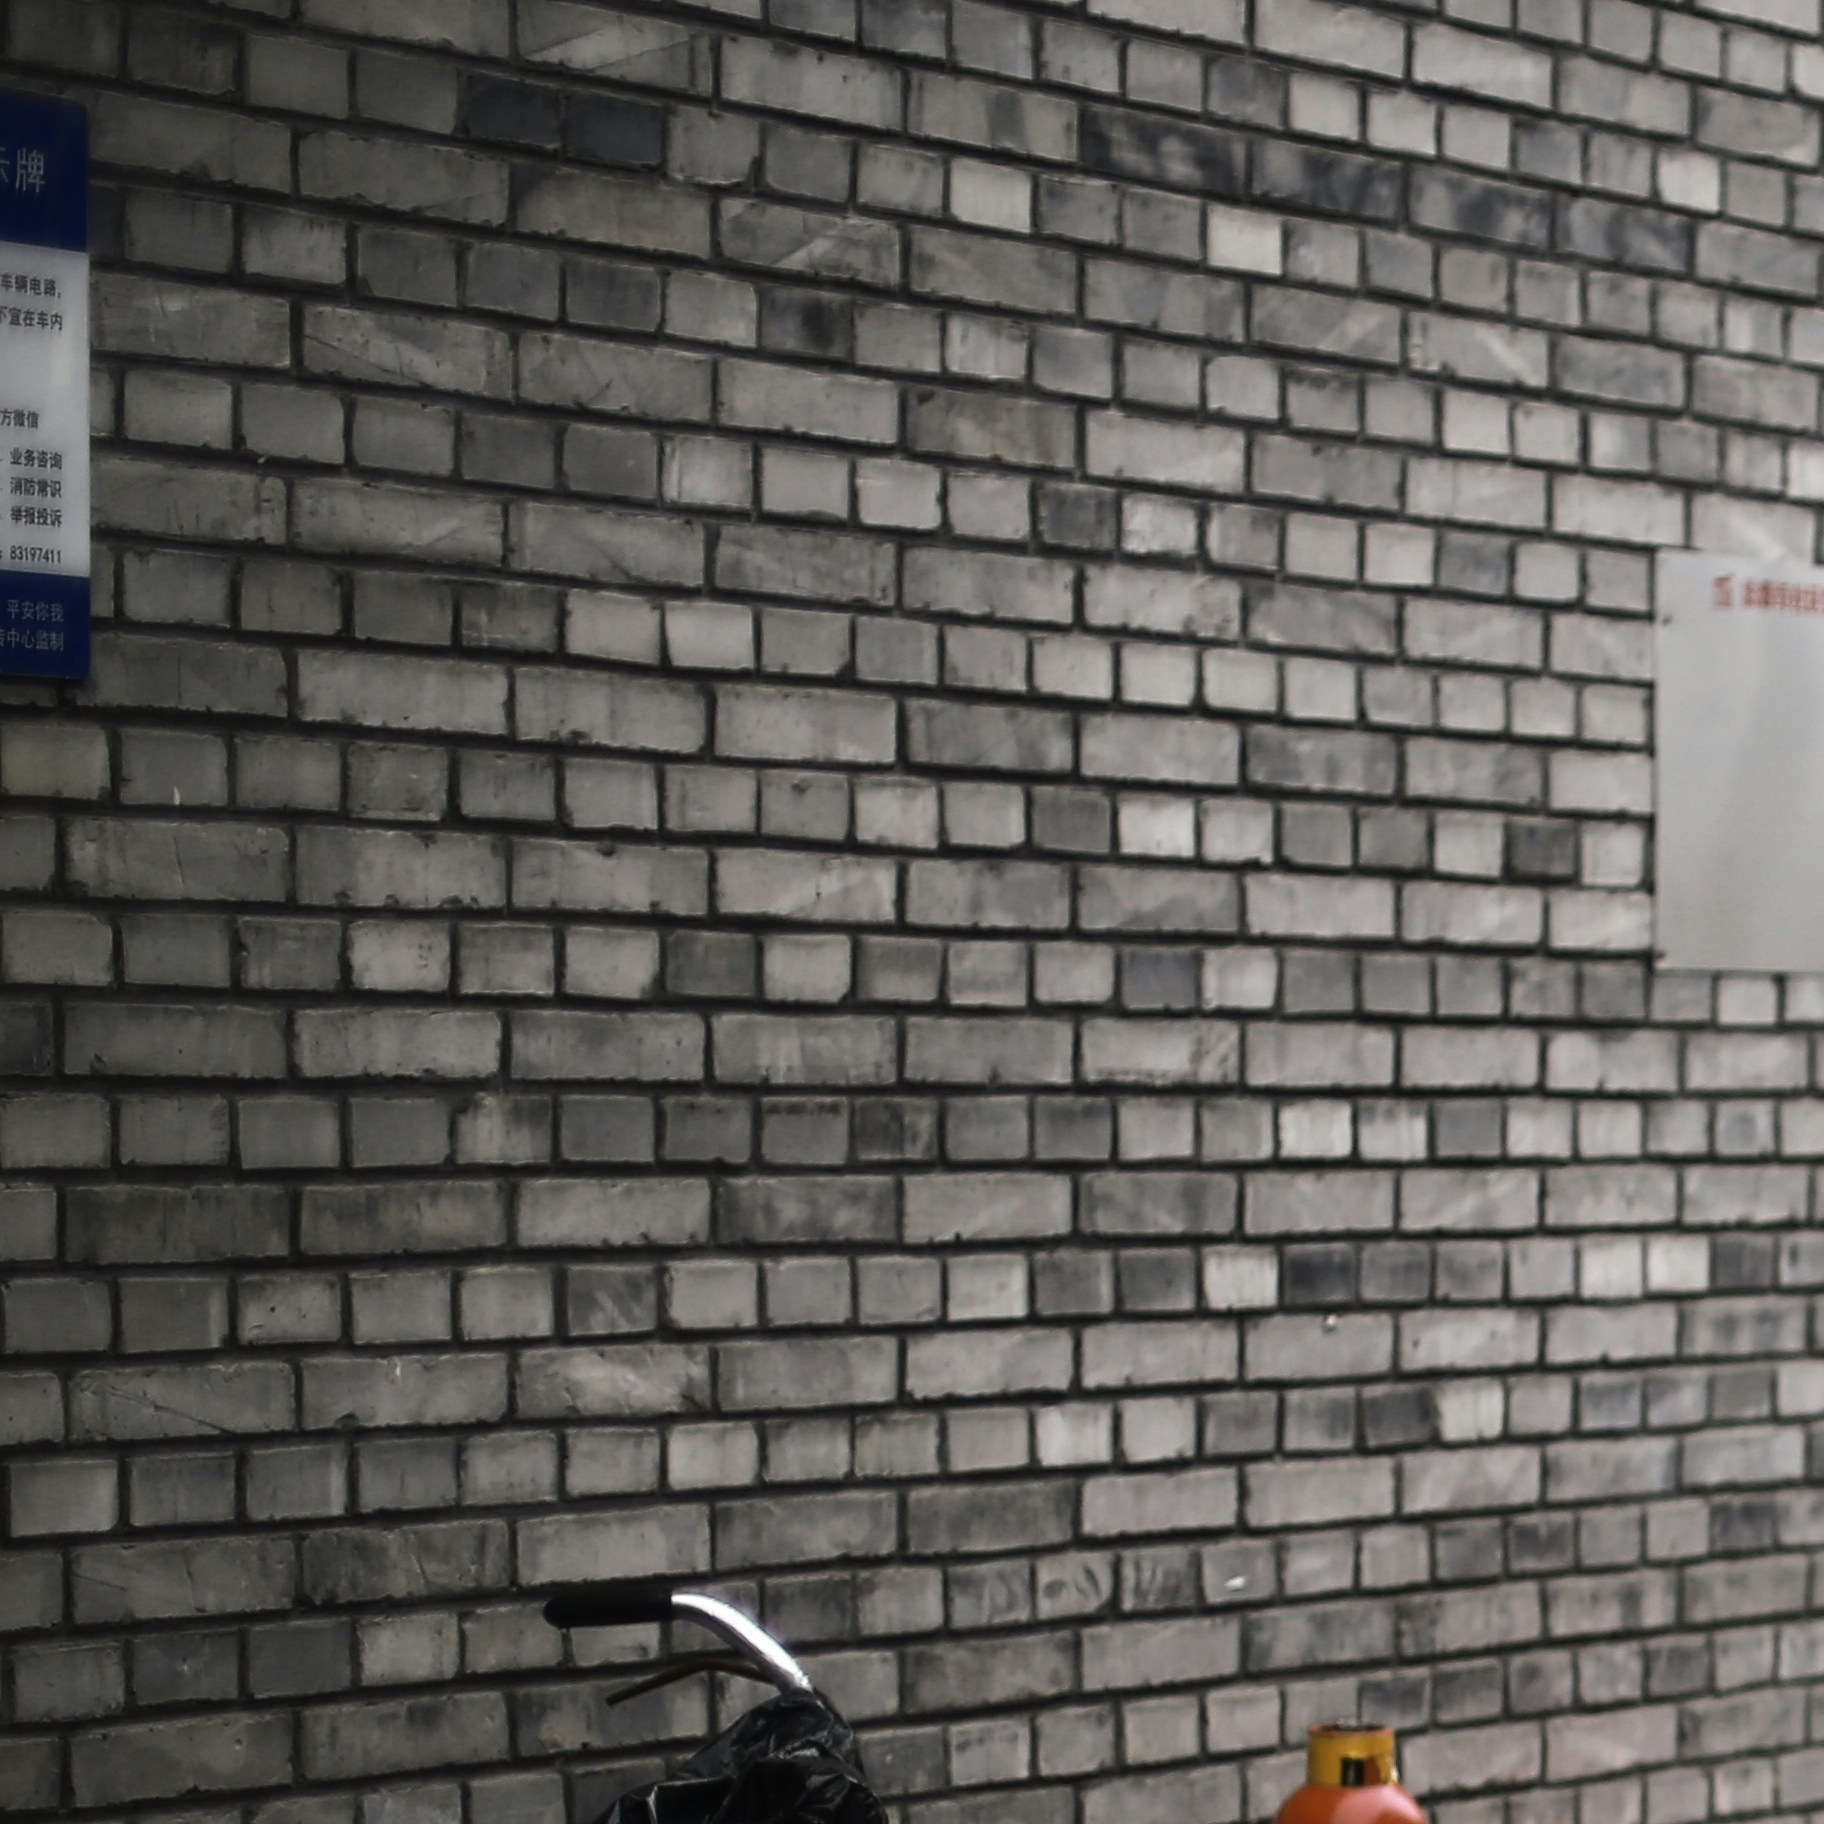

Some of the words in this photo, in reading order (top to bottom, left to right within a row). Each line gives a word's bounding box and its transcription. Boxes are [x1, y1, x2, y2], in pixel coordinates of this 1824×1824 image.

[10, 447, 62, 470] 业务咨询
[10, 476, 62, 498] 消防常识
[10, 505, 62, 528] 举报投诉
[10, 545, 62, 564] 83197411
[6, 599, 65, 623] 平安你我
